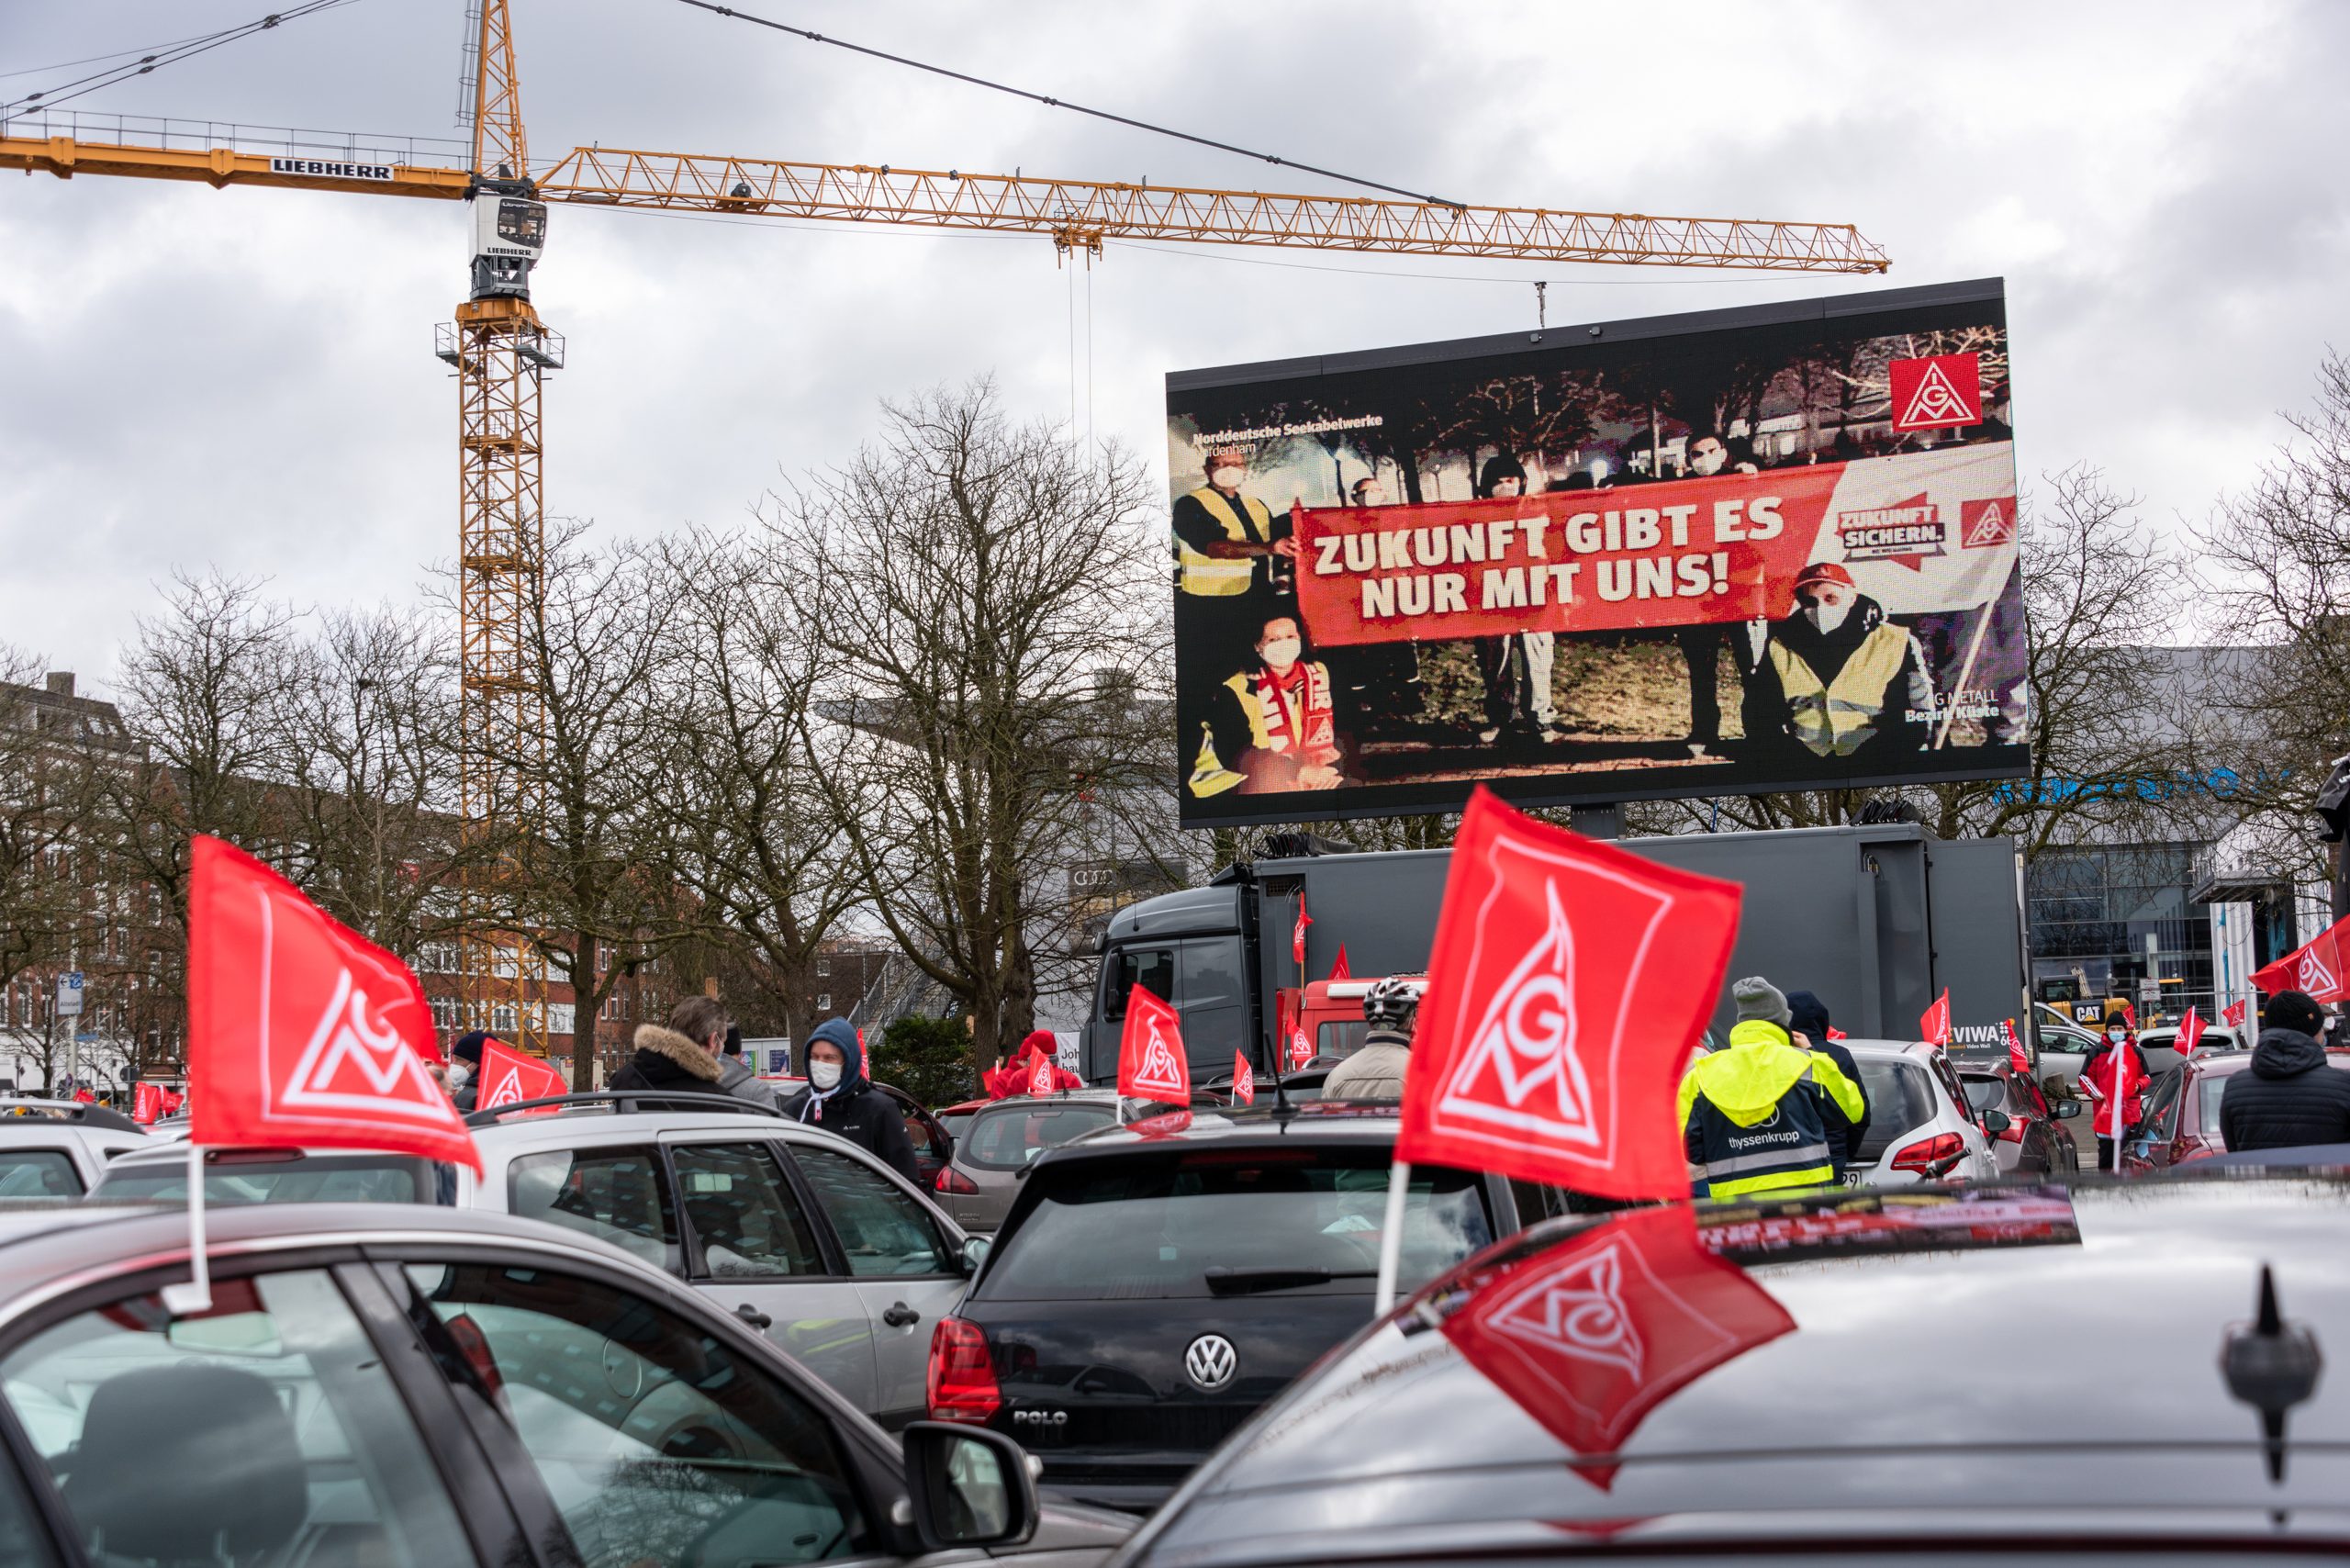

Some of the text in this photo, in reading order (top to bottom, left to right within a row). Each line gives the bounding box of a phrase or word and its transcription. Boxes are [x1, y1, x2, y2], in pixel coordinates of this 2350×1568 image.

[274, 159, 391, 180] LIEBHERR
[487, 247, 532, 256] LIEBHERR
[1192, 414, 1383, 445] Norddeutsche Seekabelwerke
[1840, 506, 1935, 530] ZUKUNFT
[1314, 496, 1785, 576] ZUKUNFT GIBT ES
[1844, 524, 1943, 547] SICHERN.
[1361, 552, 1730, 620] NUR MIT UNS!
[1956, 703, 1999, 720] Küste
[2076, 1005, 2100, 1022] CAT
[1728, 1130, 1800, 1150] thyssenkrupp
[1013, 1410, 1069, 1425] POLO
